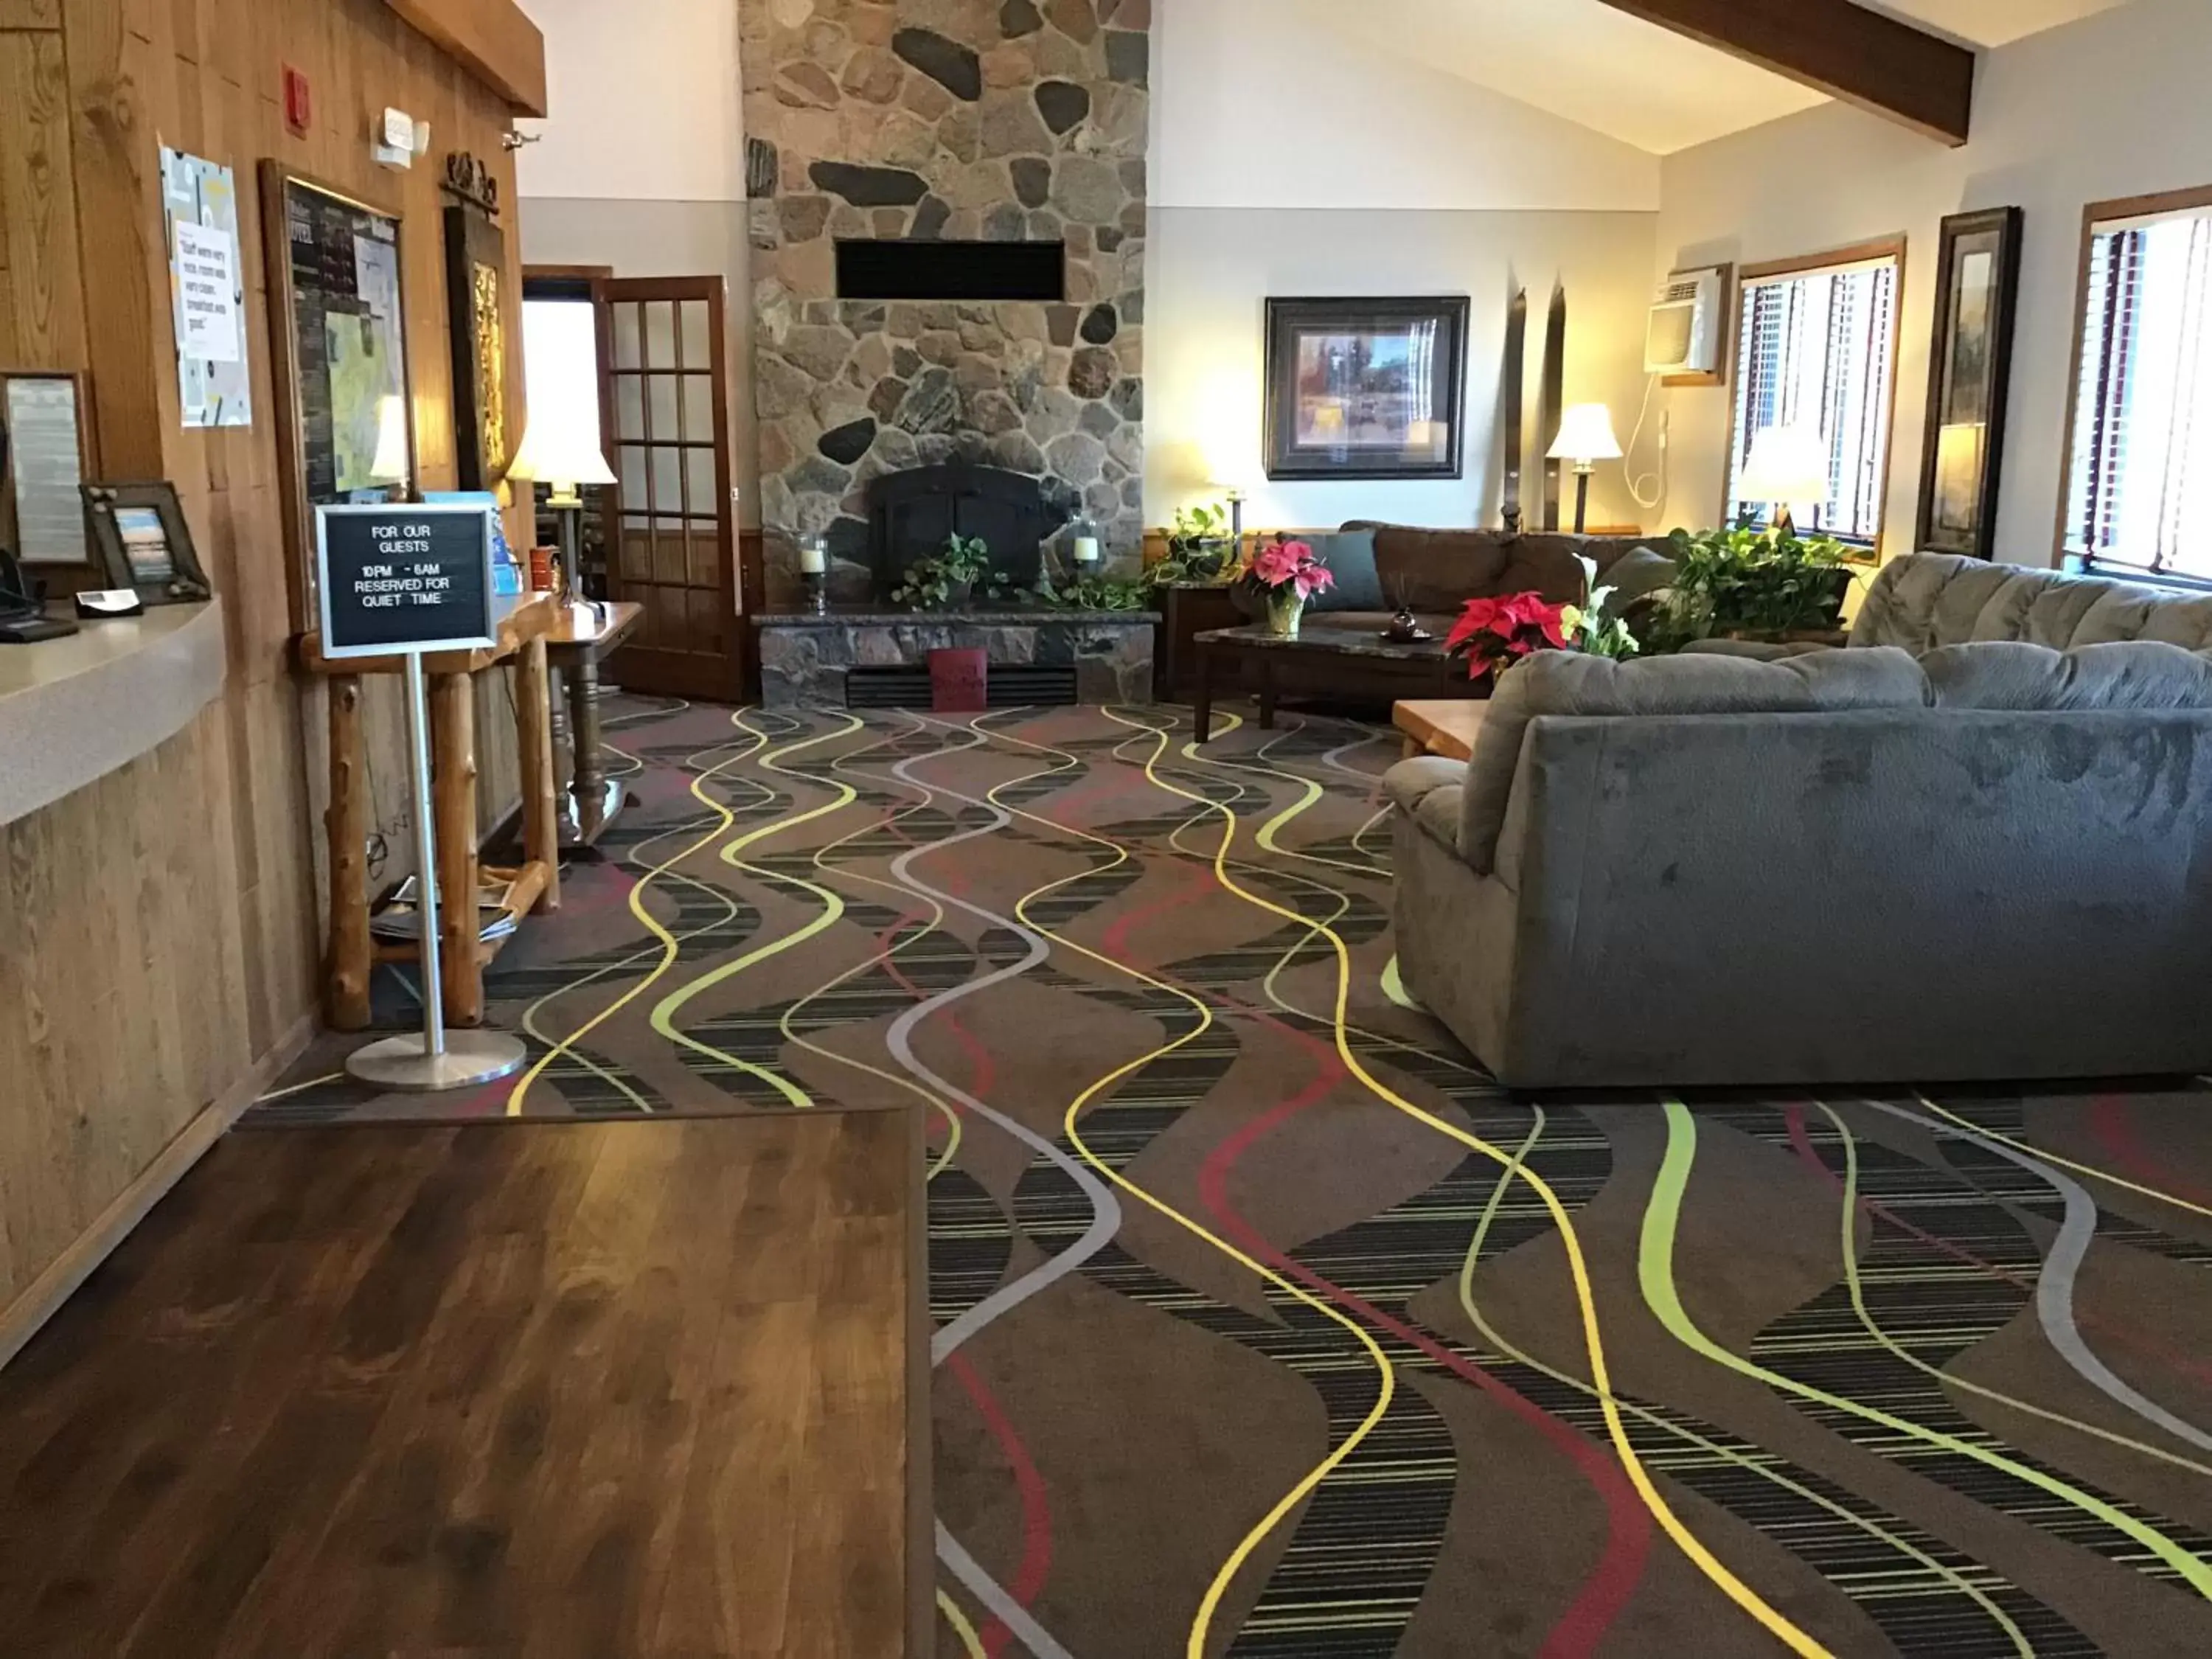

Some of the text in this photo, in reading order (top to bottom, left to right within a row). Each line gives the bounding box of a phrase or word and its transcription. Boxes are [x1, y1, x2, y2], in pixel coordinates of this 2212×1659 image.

[372, 525, 431, 539] FOR OUR
[379, 540, 429, 554] GUESTS
[361, 565, 392, 577] 10PM
[355, 577, 450, 594] RESERVED FOR
[362, 592, 442, 608] QUIET TIME
